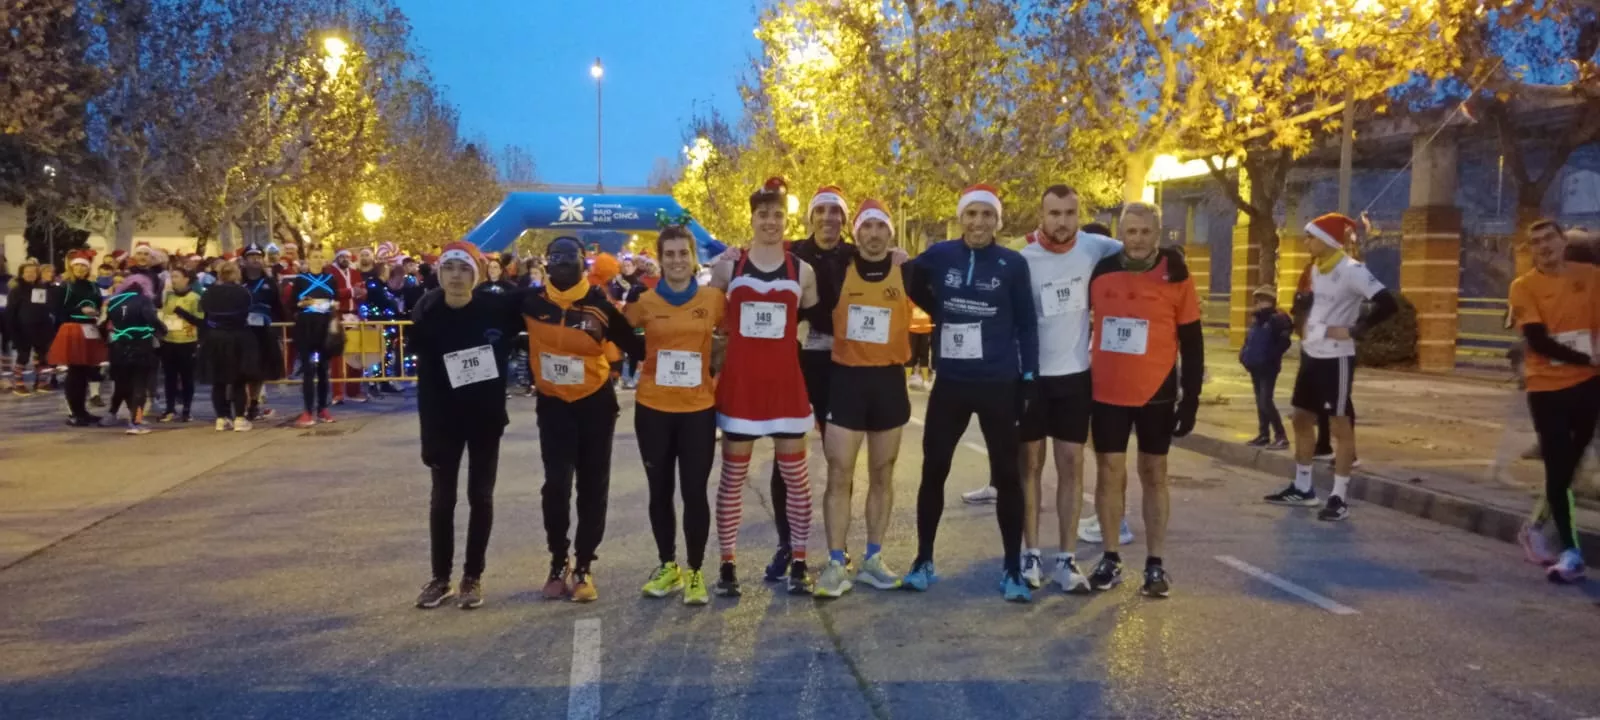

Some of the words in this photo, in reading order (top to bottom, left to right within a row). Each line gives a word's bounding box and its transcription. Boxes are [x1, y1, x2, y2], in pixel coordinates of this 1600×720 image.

[613, 212, 639, 220] CINCA
[1056, 287, 1070, 298] 119
[756, 312, 772, 322] 149
[863, 316, 875, 326] 24
[953, 333, 964, 344] 62
[461, 356, 480, 369] 216
[674, 361, 686, 371] 61
